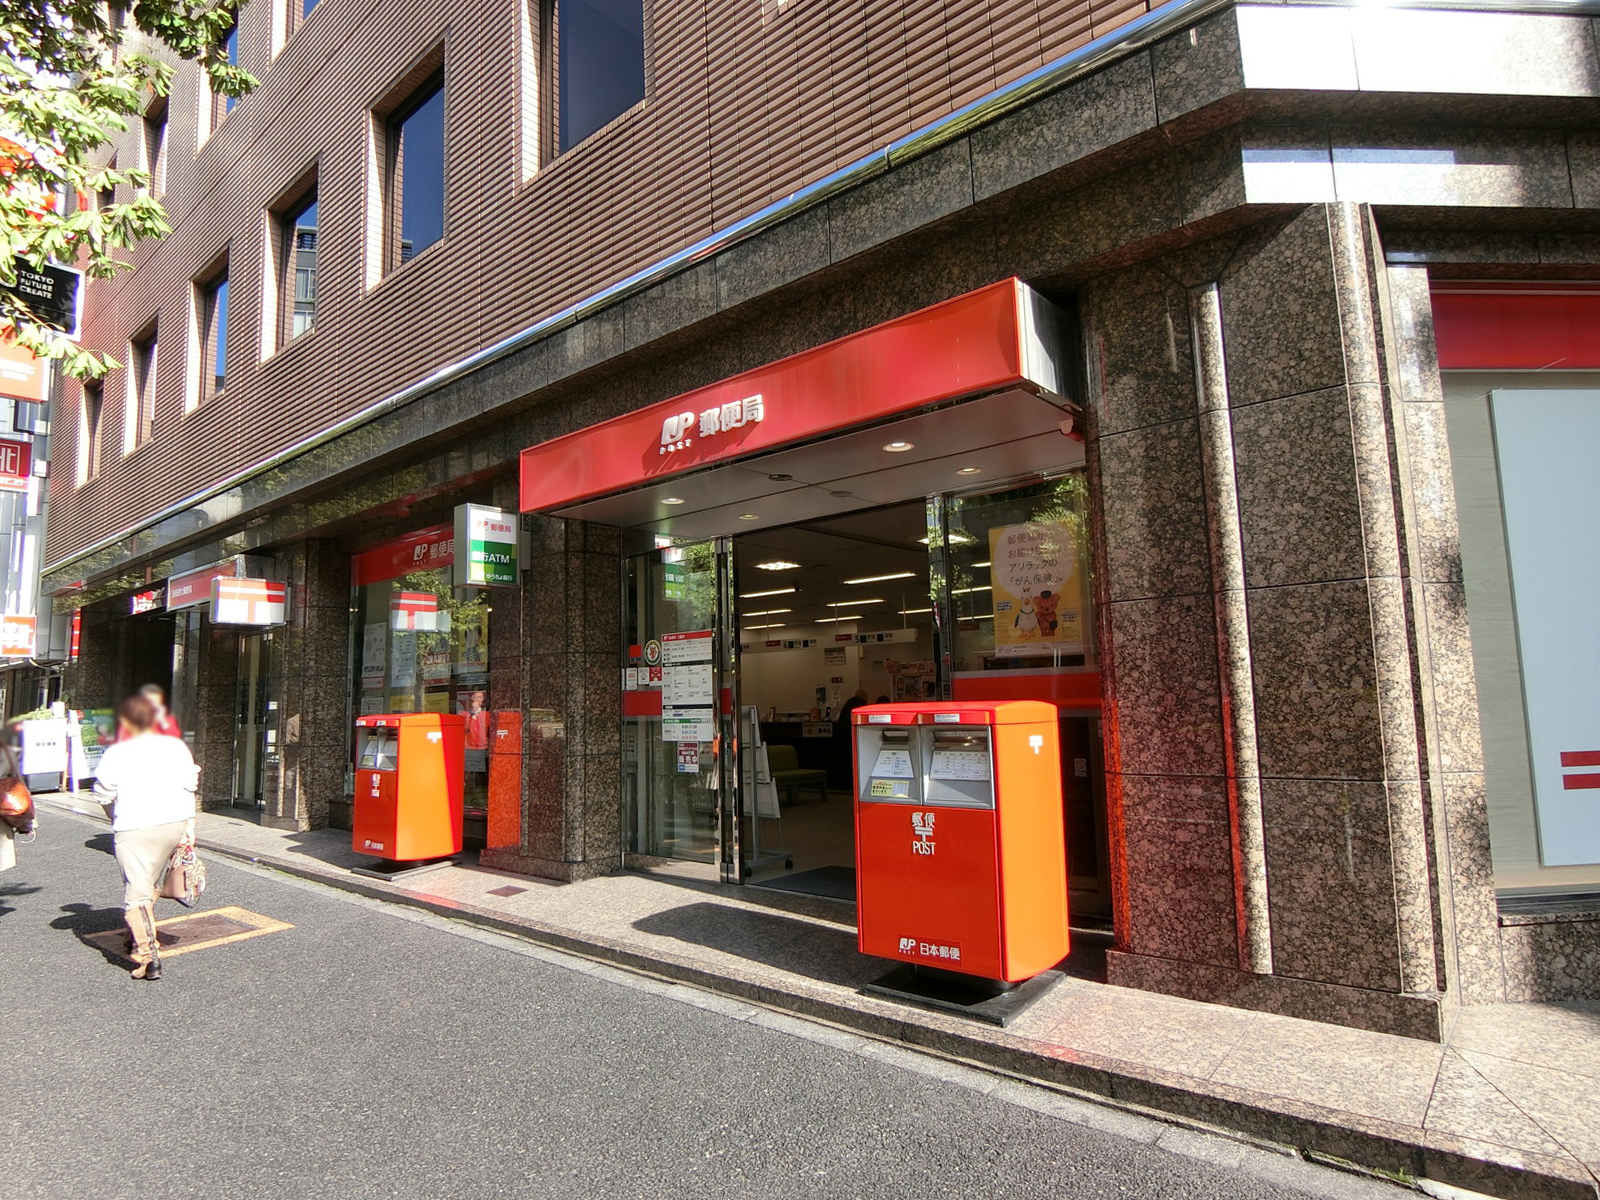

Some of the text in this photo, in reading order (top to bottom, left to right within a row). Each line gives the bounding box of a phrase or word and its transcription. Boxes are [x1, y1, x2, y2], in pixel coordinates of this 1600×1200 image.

[20, 270, 54, 285] TOKYO
[20, 277, 53, 292] FUTURE
[19, 285, 52, 299] CREATE
[699, 394, 764, 437] 郵便局
[659, 439, 692, 454] POST
[491, 524, 512, 534] 郵便局
[430, 539, 454, 559] 郵便局
[1009, 559, 1057, 573] アフラックの
[486, 573, 513, 582] ゆうちょ銀行
[783, 641, 788, 649] 6
[855, 634, 860, 643] 5
[911, 812, 936, 829] 郵便
[912, 841, 936, 855] POST
[919, 942, 960, 961] 日本郵便
